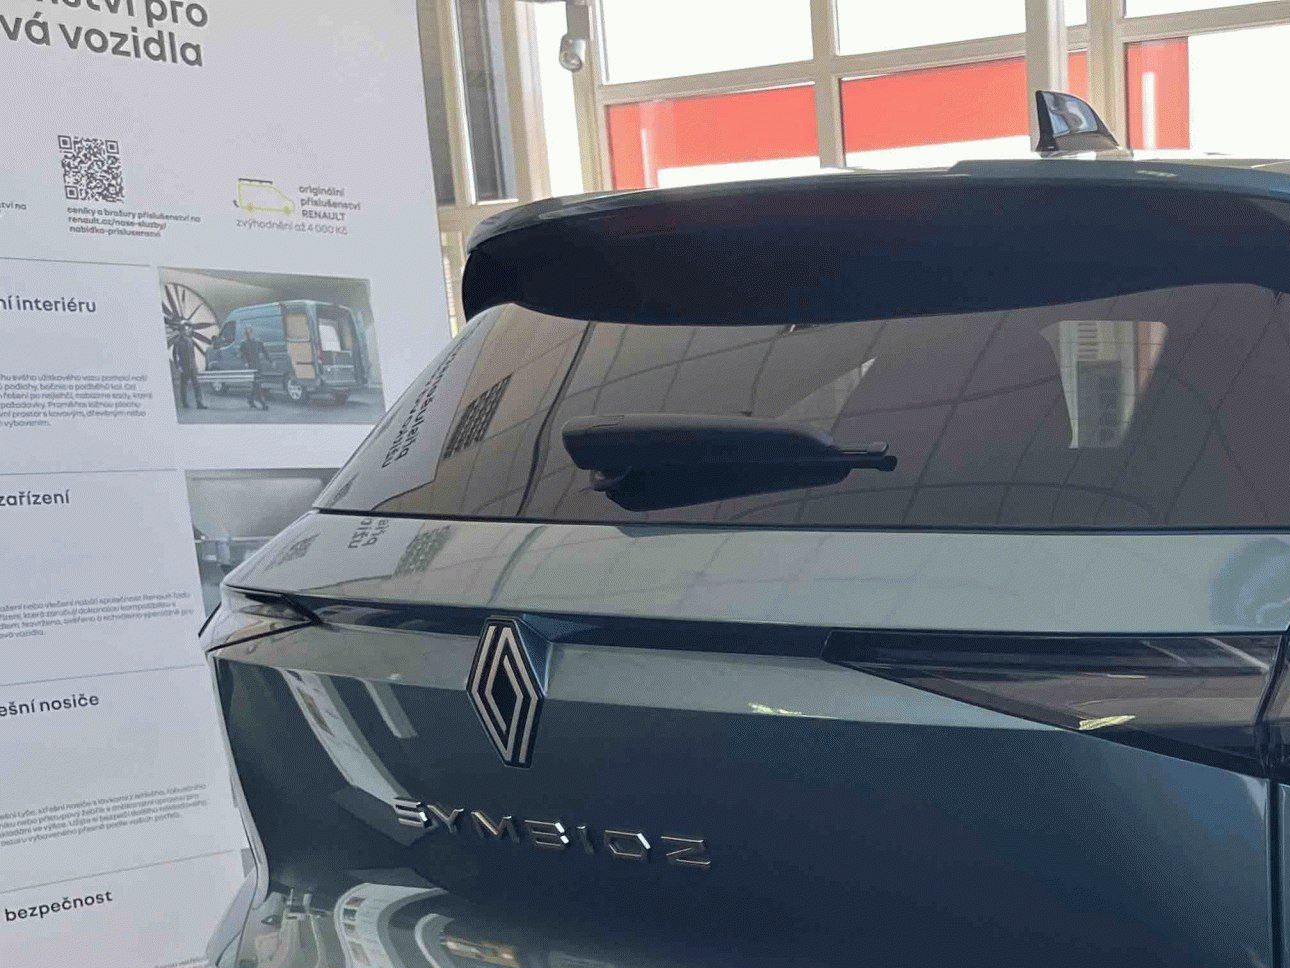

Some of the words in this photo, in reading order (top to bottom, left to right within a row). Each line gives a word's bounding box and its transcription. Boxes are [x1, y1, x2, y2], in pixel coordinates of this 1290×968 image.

[145, 0, 208, 28] pro
[58, 26, 203, 67] vozidla
[301, 209, 346, 220] RENAULT
[16, 295, 96, 312] interiéru
[39, 693, 99, 712] nosiče
[392, 798, 711, 865] SYMBIOZ
[4, 891, 113, 922] bezpečnost
